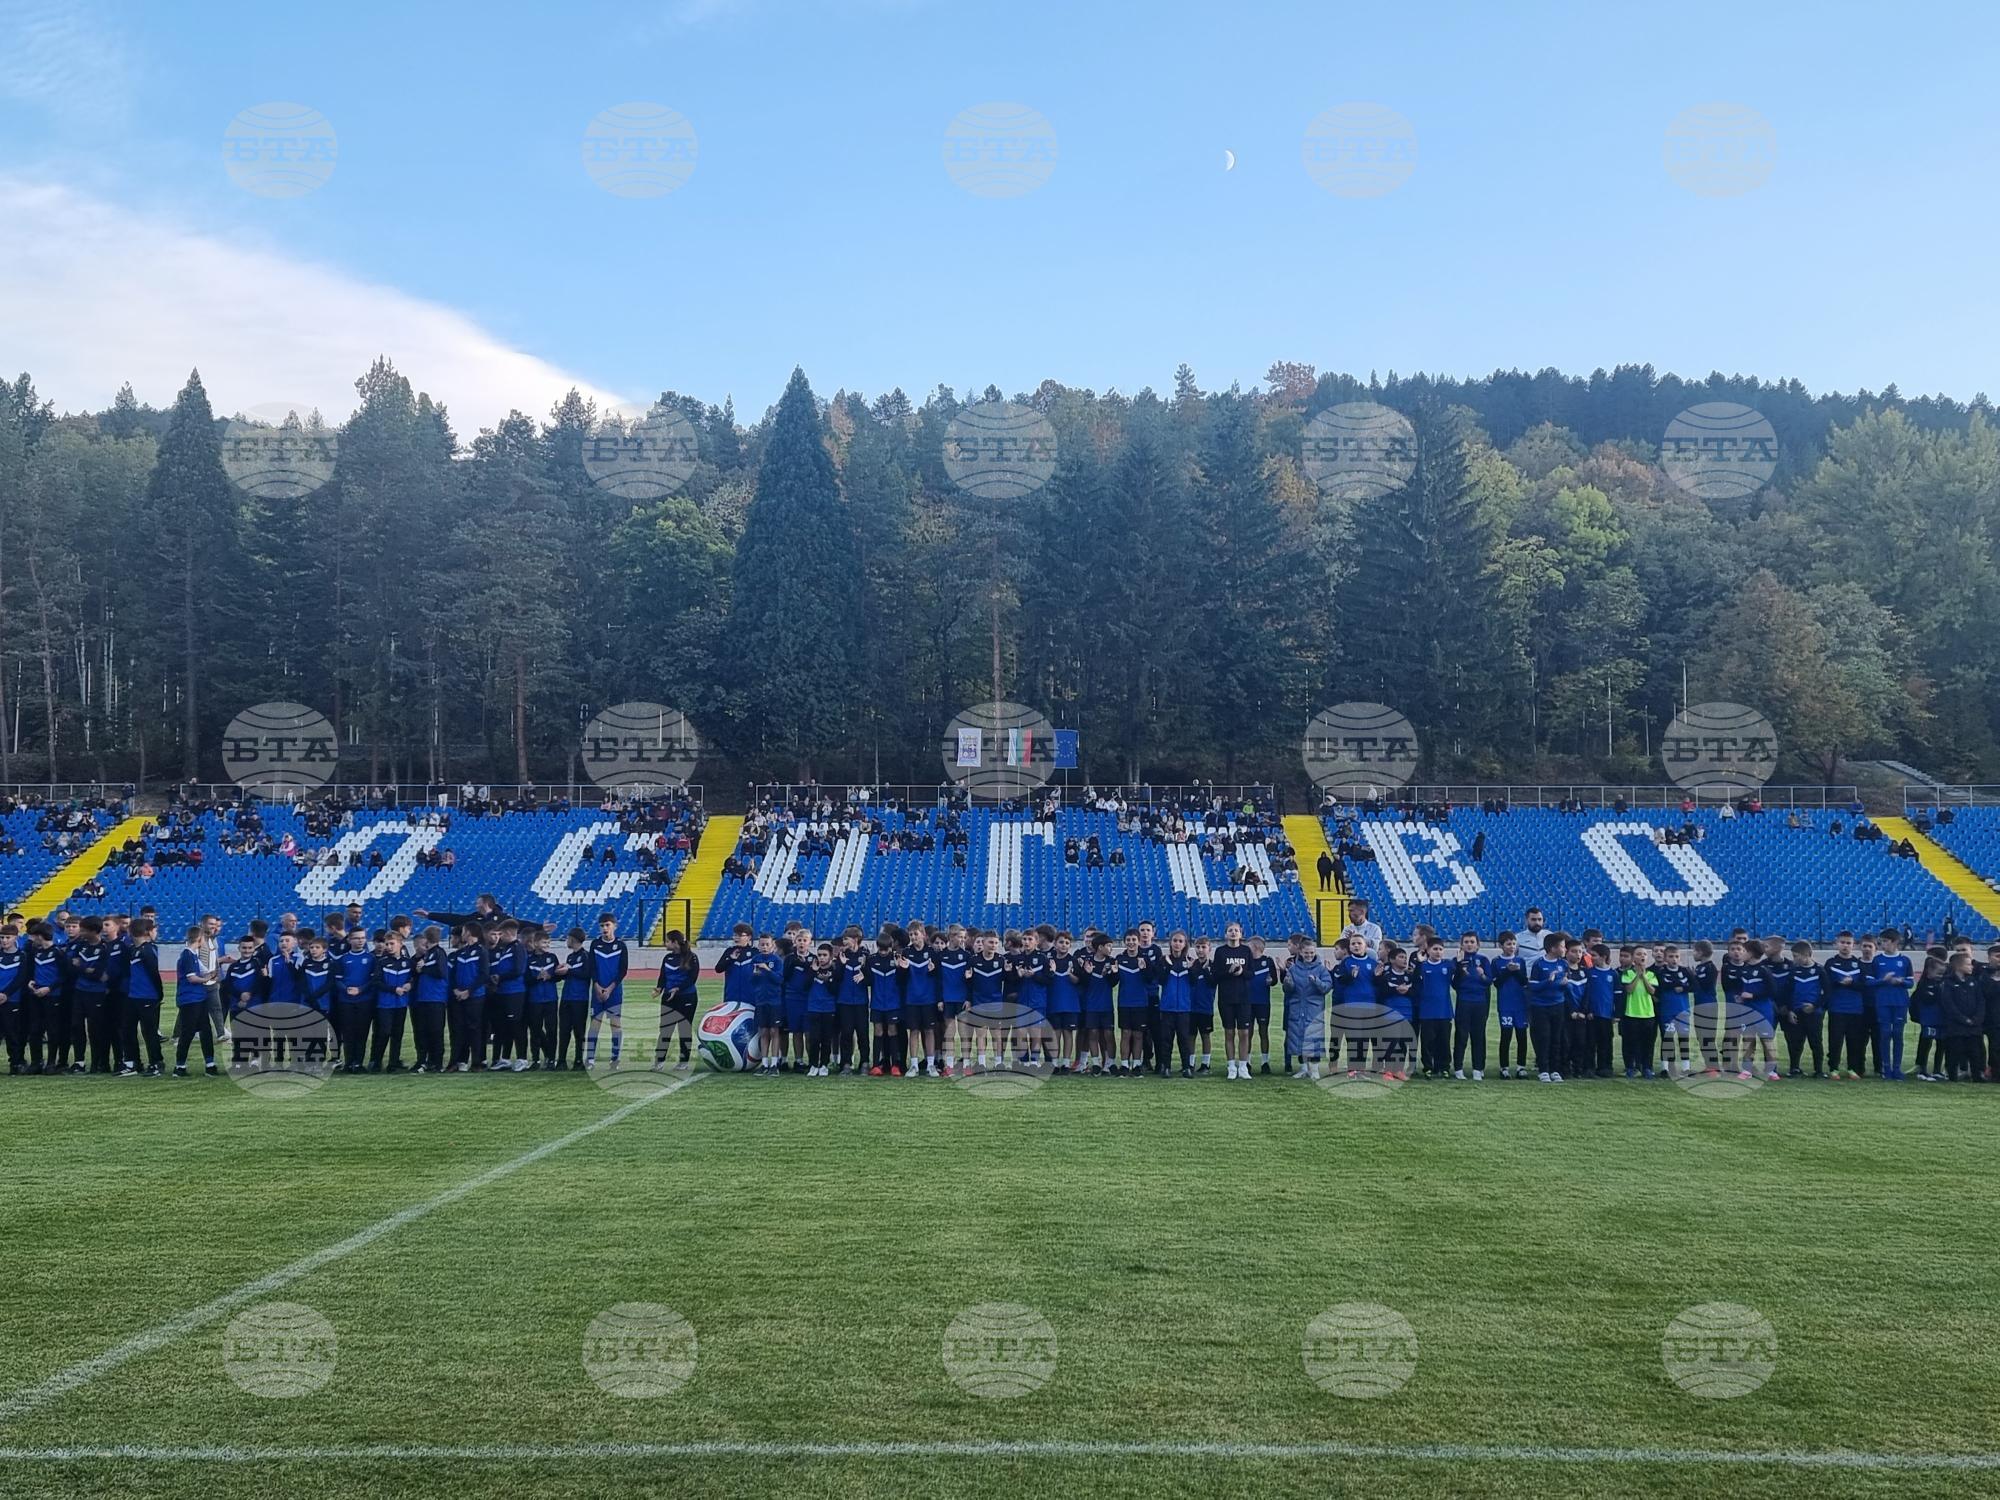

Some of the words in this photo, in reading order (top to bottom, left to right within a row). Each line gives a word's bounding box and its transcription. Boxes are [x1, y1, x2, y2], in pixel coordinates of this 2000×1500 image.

[1225, 957, 1246, 965] JAKO
[1501, 1016, 1513, 1026] 32
[1664, 1022, 1676, 1032] 25
